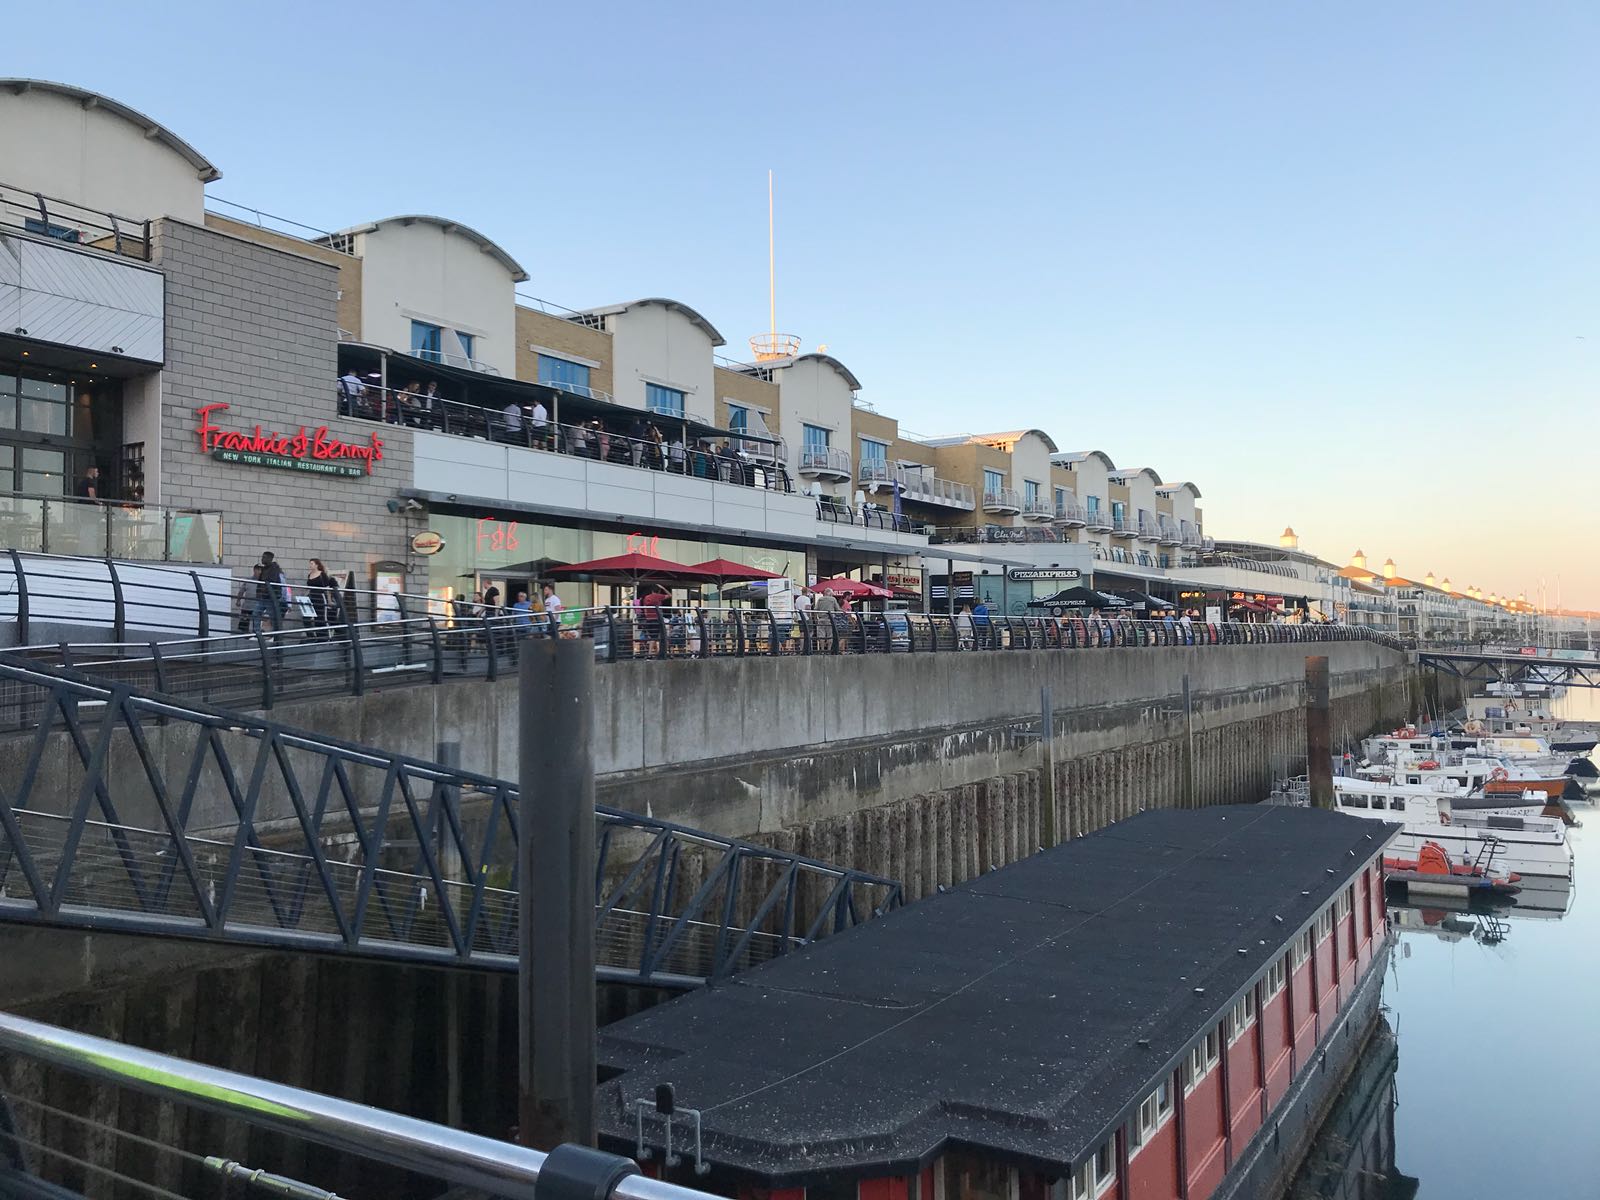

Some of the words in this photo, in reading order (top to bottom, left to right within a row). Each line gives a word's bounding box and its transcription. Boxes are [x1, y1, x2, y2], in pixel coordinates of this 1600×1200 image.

[196, 403, 289, 455] Frankie
[291, 424, 309, 459] &
[313, 425, 385, 477] Benny's
[223, 452, 240, 461] NEW
[243, 455, 262, 464] YORK
[266, 458, 292, 468] ITALIAN
[297, 461, 338, 473] RESTAURANT
[348, 468, 361, 476] BAR
[1013, 570, 1079, 578] PIZZAEXPRESS
